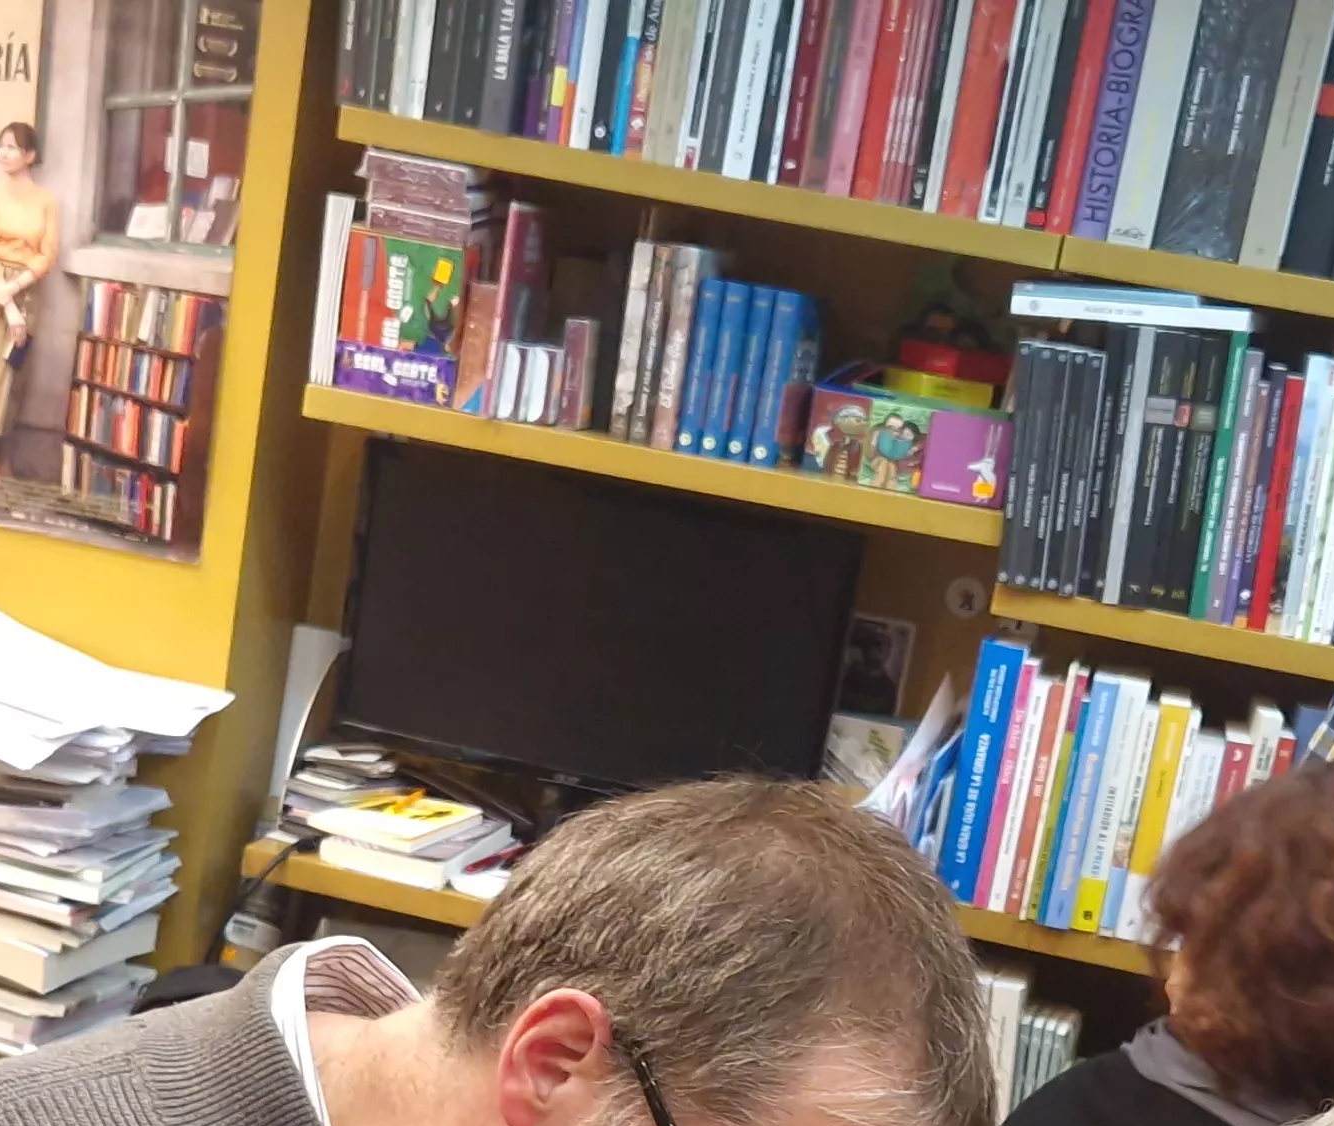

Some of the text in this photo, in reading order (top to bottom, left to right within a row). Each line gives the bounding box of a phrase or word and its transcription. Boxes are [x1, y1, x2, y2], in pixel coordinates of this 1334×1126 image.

[954, 731, 991, 864] LA GRAN GUÍA DE LA CRIANZA
